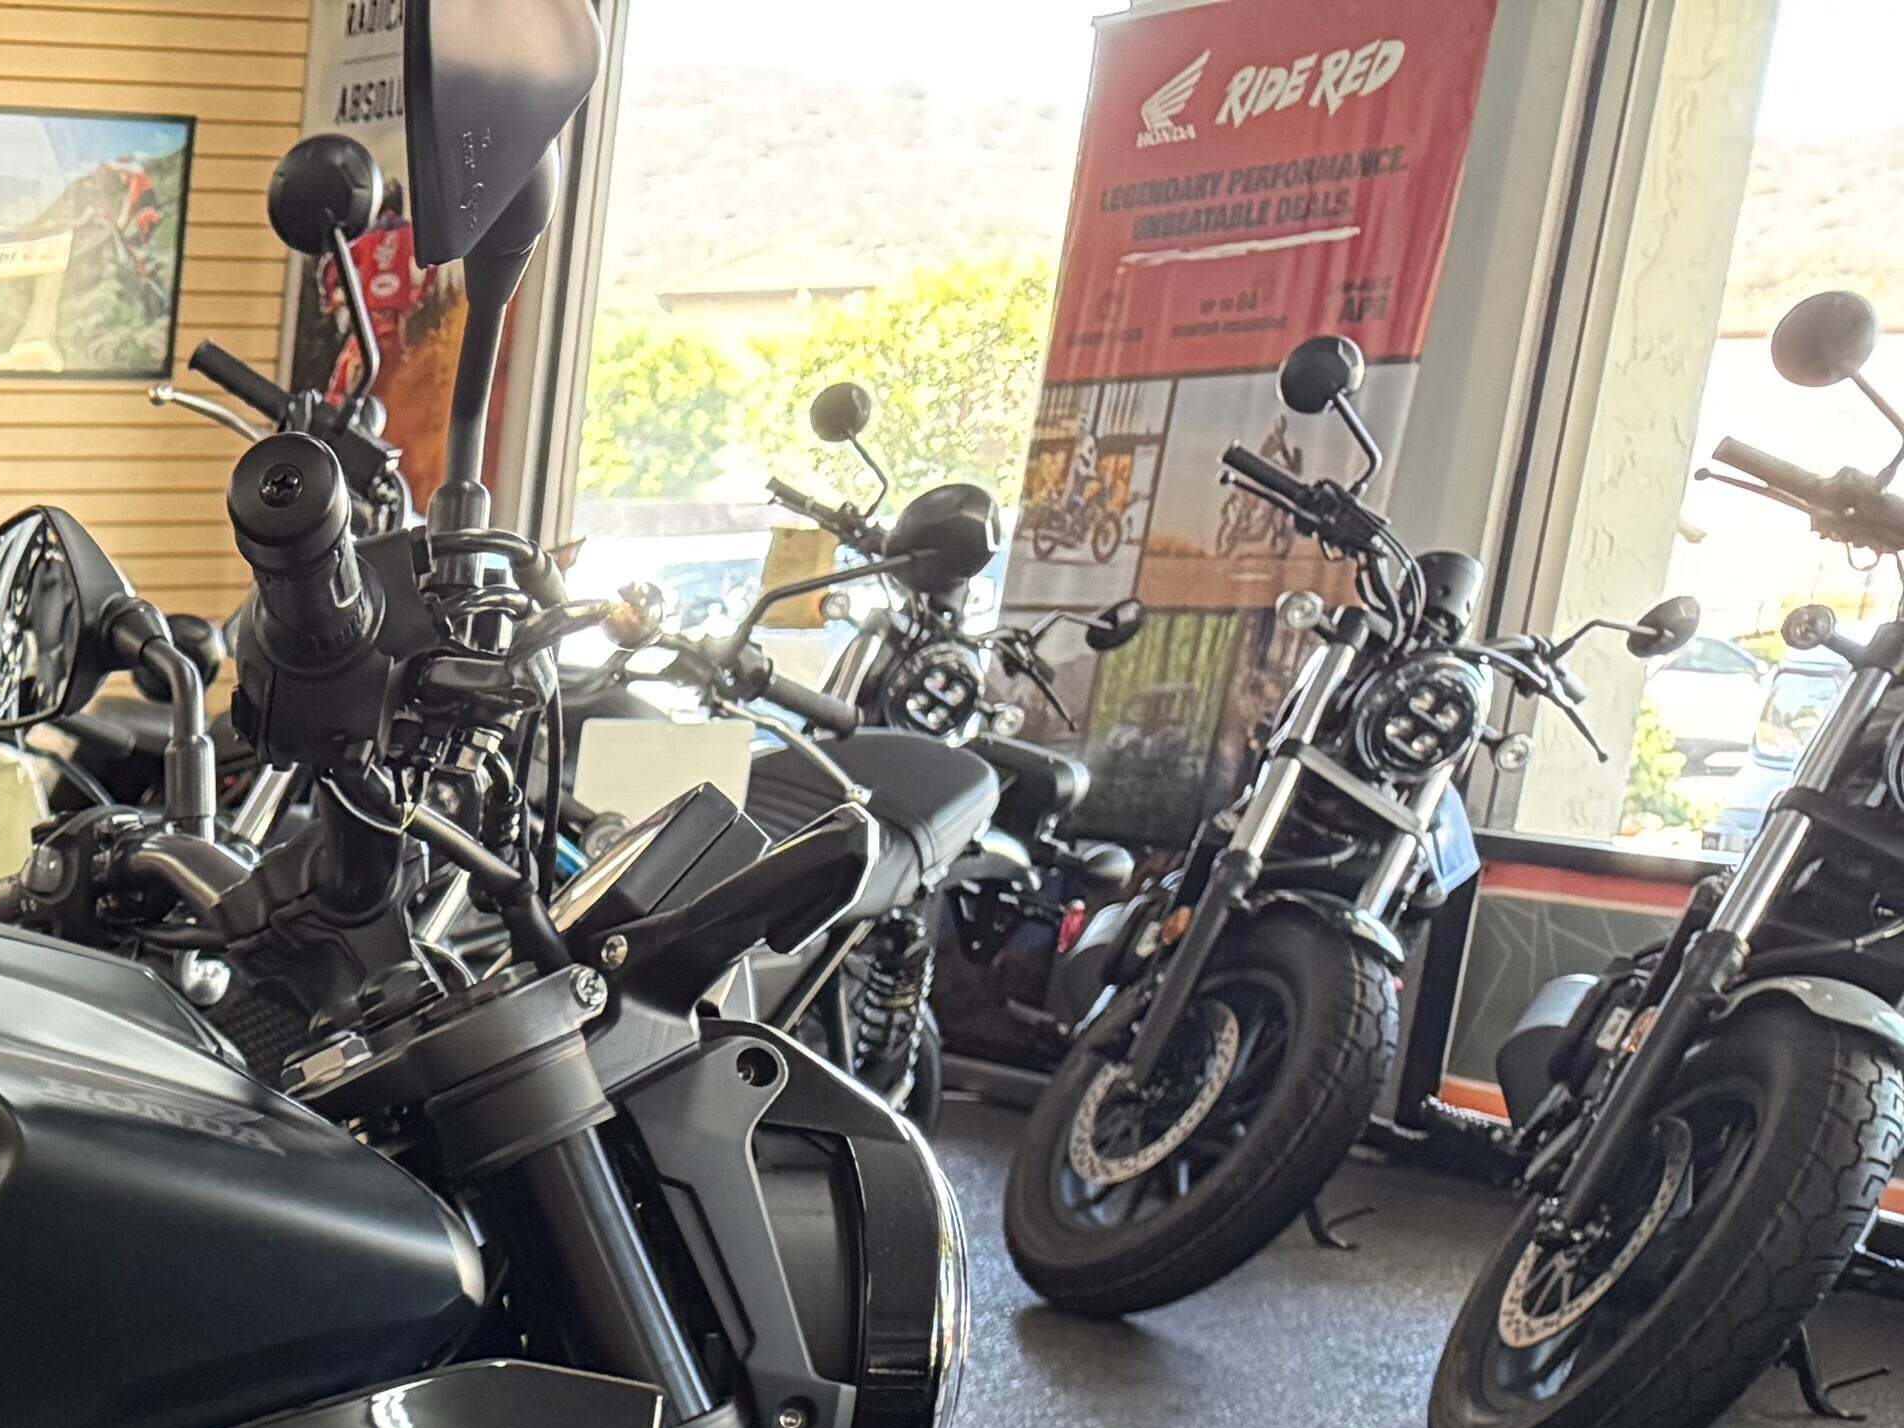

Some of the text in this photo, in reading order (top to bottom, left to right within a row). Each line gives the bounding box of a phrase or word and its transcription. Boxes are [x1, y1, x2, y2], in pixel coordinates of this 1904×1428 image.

[1215, 39, 1406, 128] RIDE RED
[1136, 123, 1196, 148] HONDA
[1100, 169, 1225, 213] LEGENDARY
[1132, 202, 1271, 241] UNBEATABLE
[38, 1078, 286, 1157] HONDA
